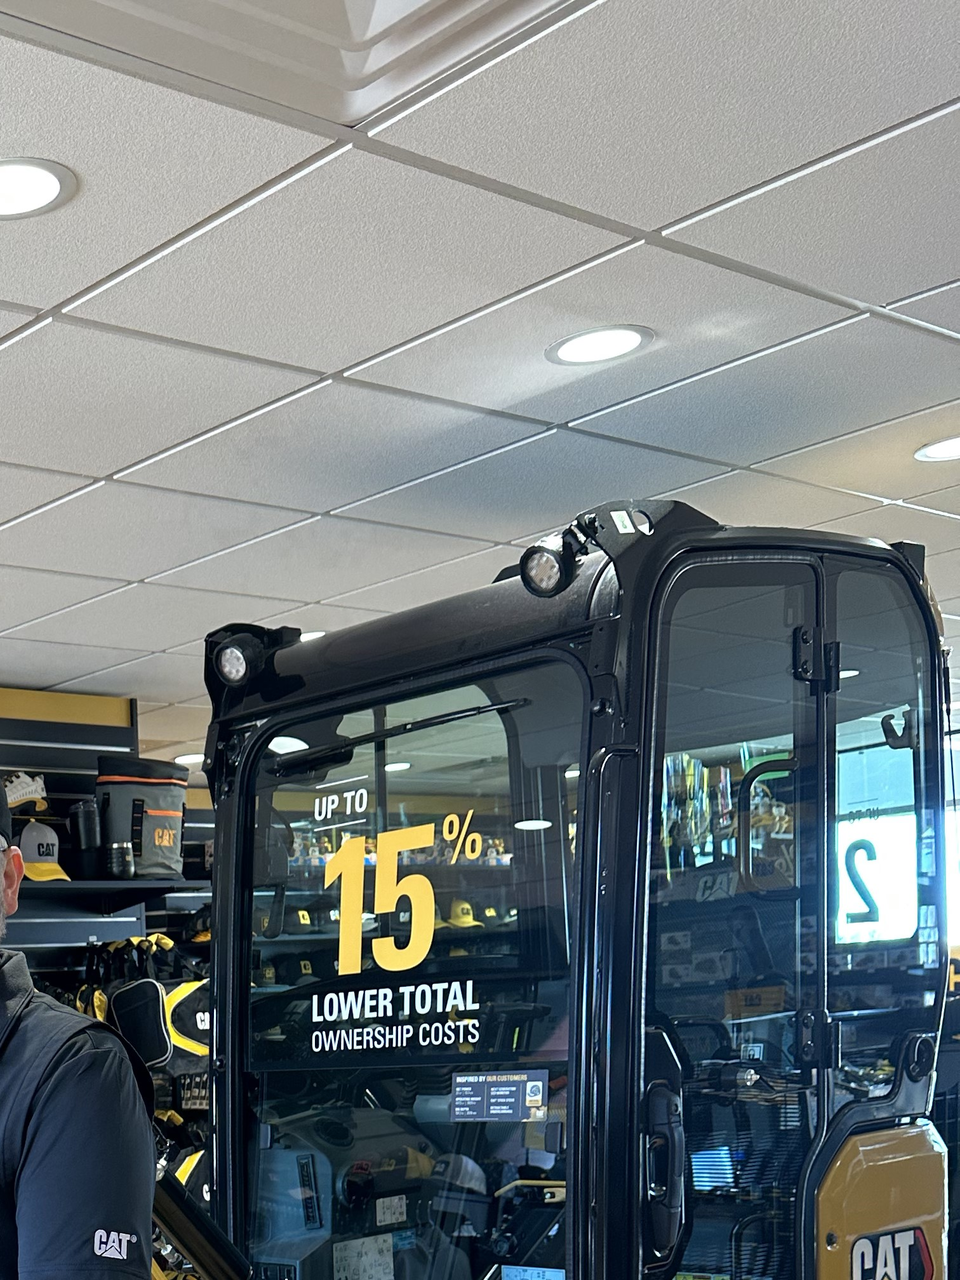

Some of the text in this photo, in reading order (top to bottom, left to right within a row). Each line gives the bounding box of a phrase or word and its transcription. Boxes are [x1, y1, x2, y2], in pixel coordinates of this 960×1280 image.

[314, 788, 368, 821] UP TO
[38, 842, 56, 857] CAT
[154, 828, 175, 847] CAT
[312, 980, 480, 1023] LOWER TOTAL
[311, 1020, 480, 1053] OWNERSHIP COSTS
[94, 1229, 131, 1260] CAT
